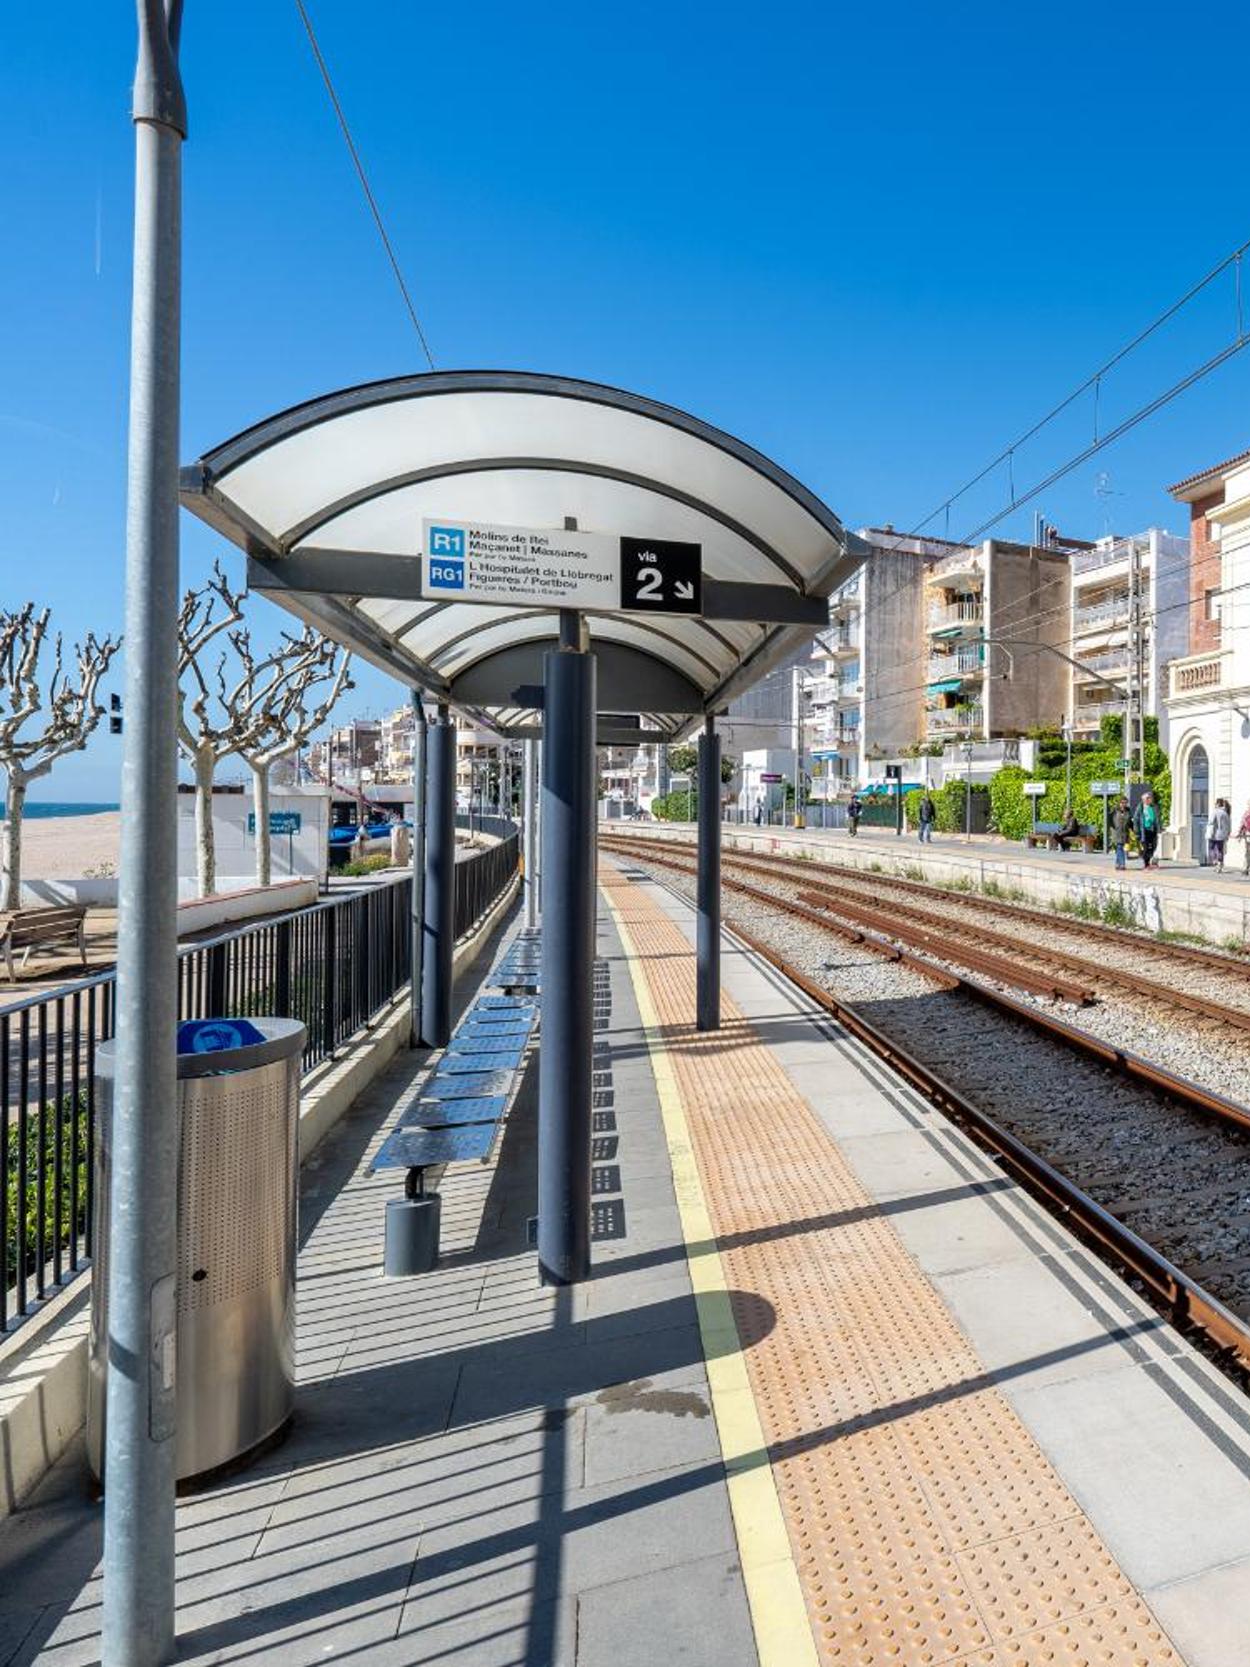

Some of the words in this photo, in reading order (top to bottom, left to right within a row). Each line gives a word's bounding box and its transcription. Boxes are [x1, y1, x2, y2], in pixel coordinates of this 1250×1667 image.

[433, 533, 462, 550] R1
[469, 530, 509, 542] Molins
[511, 533, 526, 544] de
[529, 534, 549, 545] Rei
[469, 541, 520, 553] Maçanet
[530, 546, 588, 559] Massanes
[637, 550, 657, 563] via
[431, 567, 463, 582] RG1
[469, 572, 521, 584] Figueres
[531, 577, 578, 589] Portbou
[543, 568, 558, 577] de
[561, 568, 614, 582] Llobregat
[636, 567, 663, 600] 2
